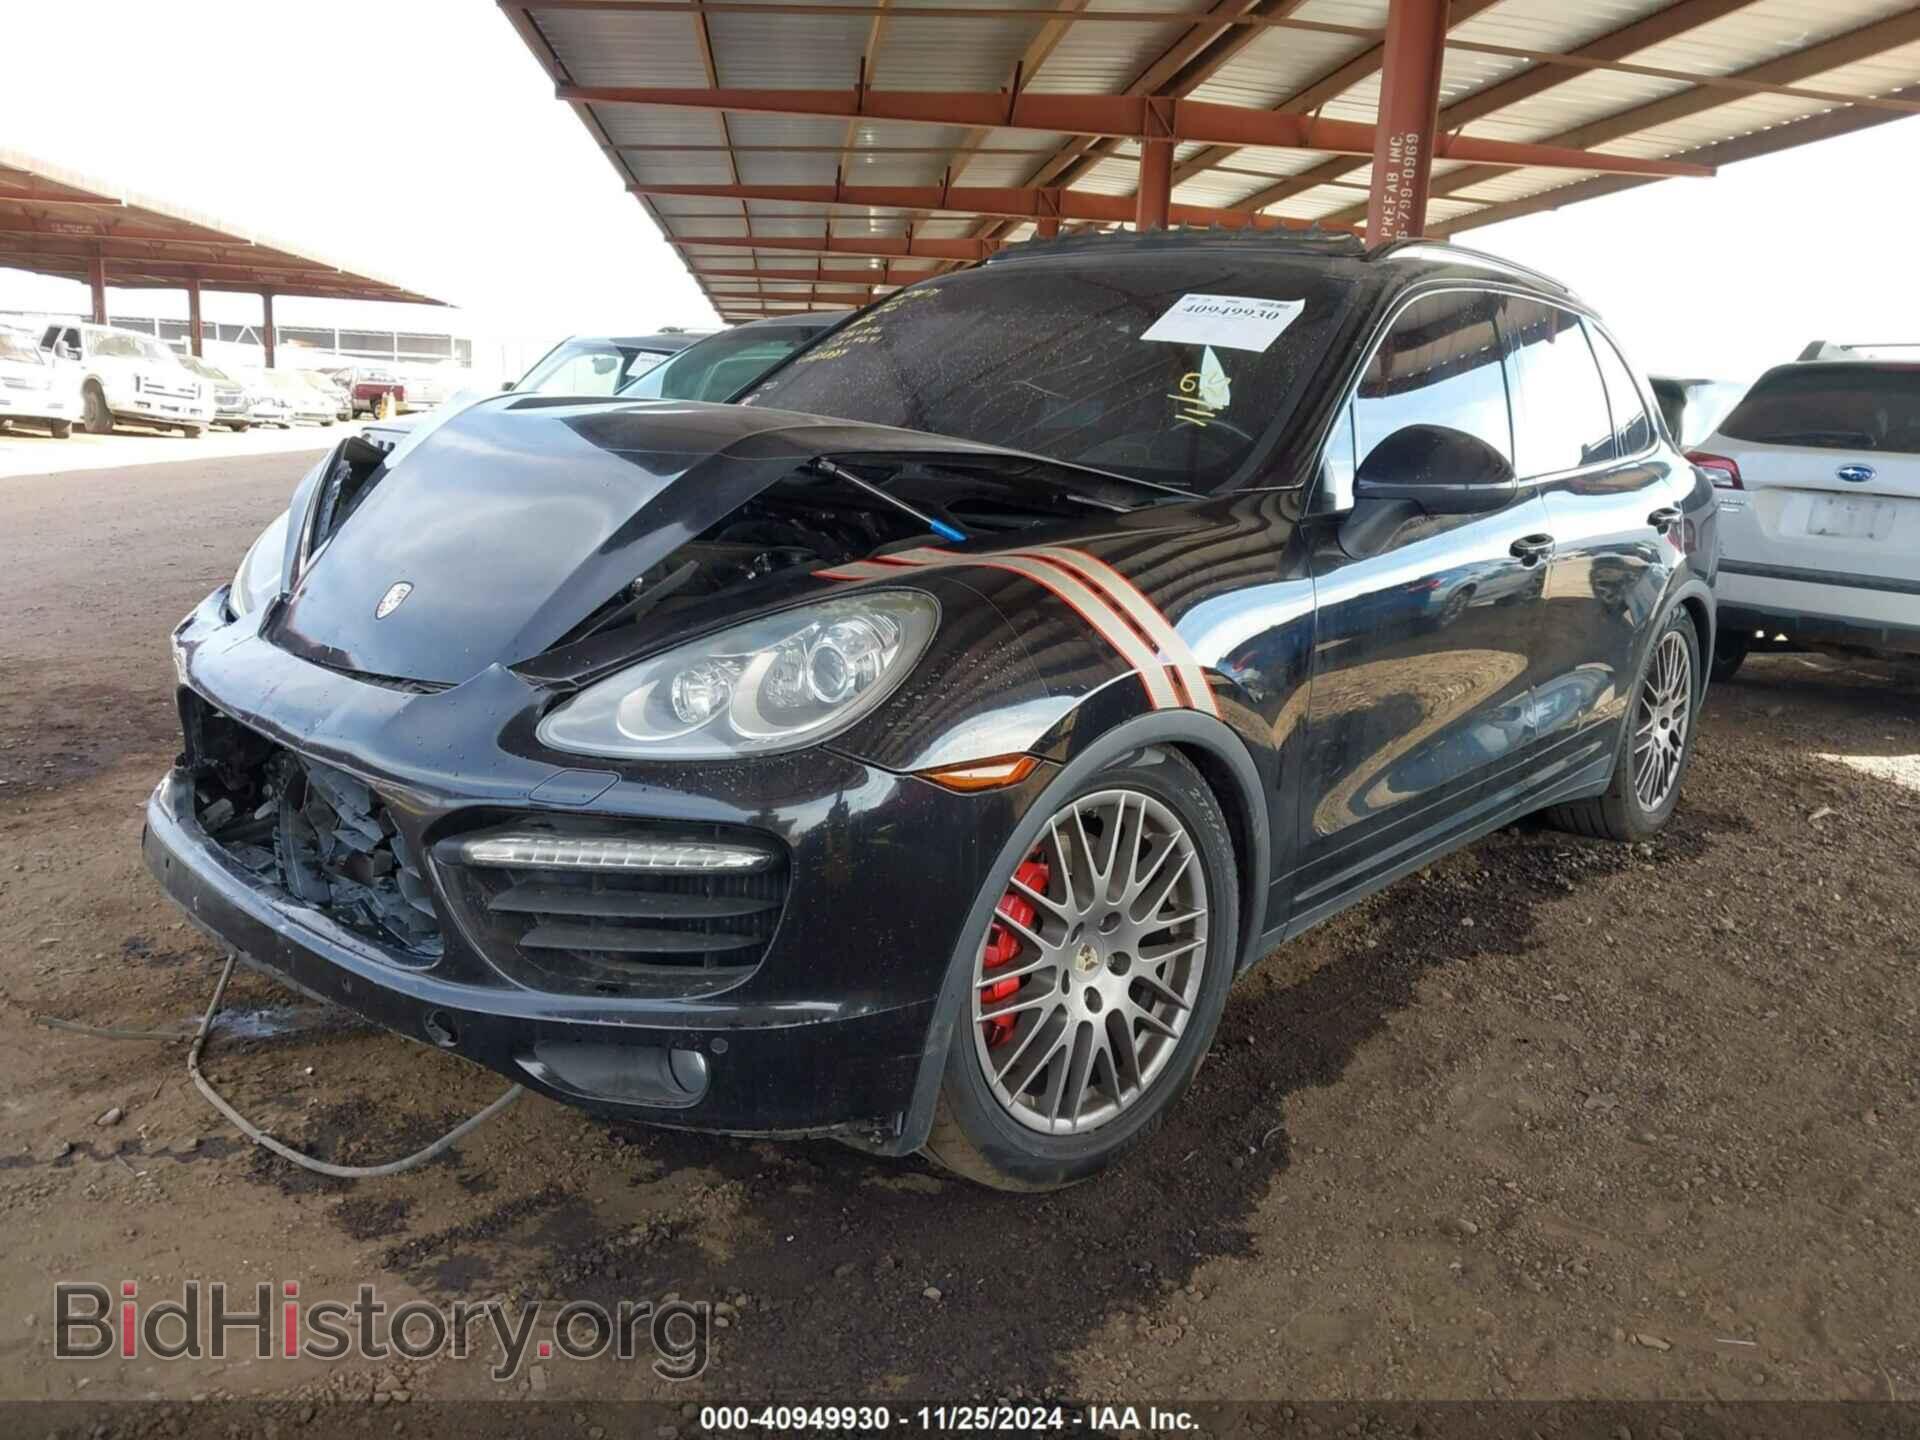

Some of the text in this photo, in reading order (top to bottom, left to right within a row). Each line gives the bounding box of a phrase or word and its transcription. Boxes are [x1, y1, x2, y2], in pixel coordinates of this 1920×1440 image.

[1380, 131, 1405, 237] PREFAB INC.
[1183, 303, 1280, 321] 40949930
